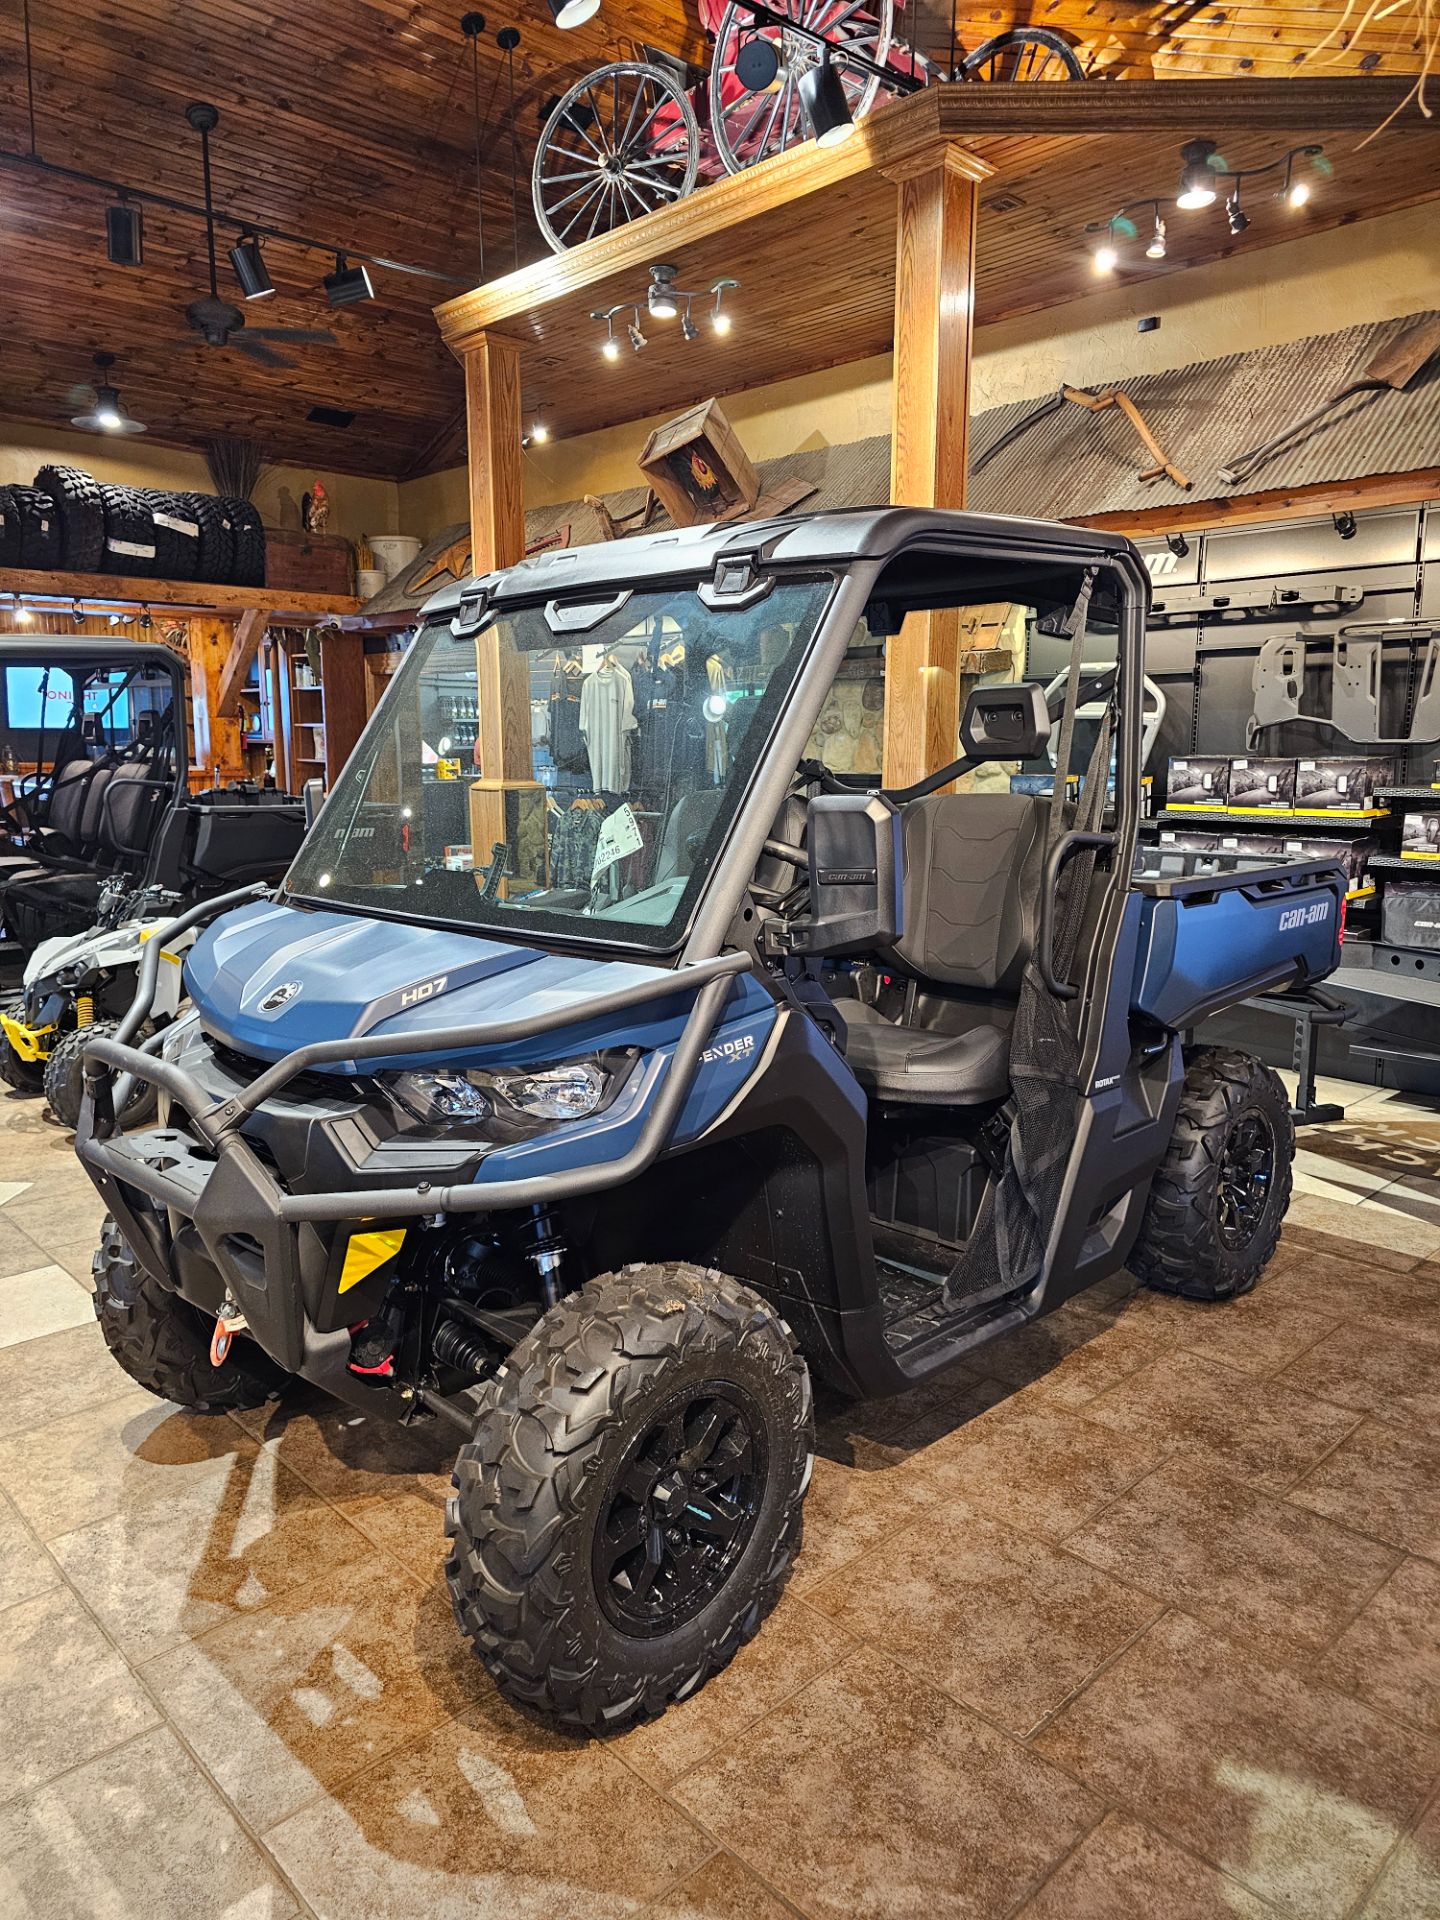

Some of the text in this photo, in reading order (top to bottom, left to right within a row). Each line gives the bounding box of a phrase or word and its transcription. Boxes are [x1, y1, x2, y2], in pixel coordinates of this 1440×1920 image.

[1279, 901, 1329, 931] can-am
[401, 976, 448, 1006] HD7
[699, 1035, 754, 1063] ENDER
[727, 1047, 755, 1065] XT
